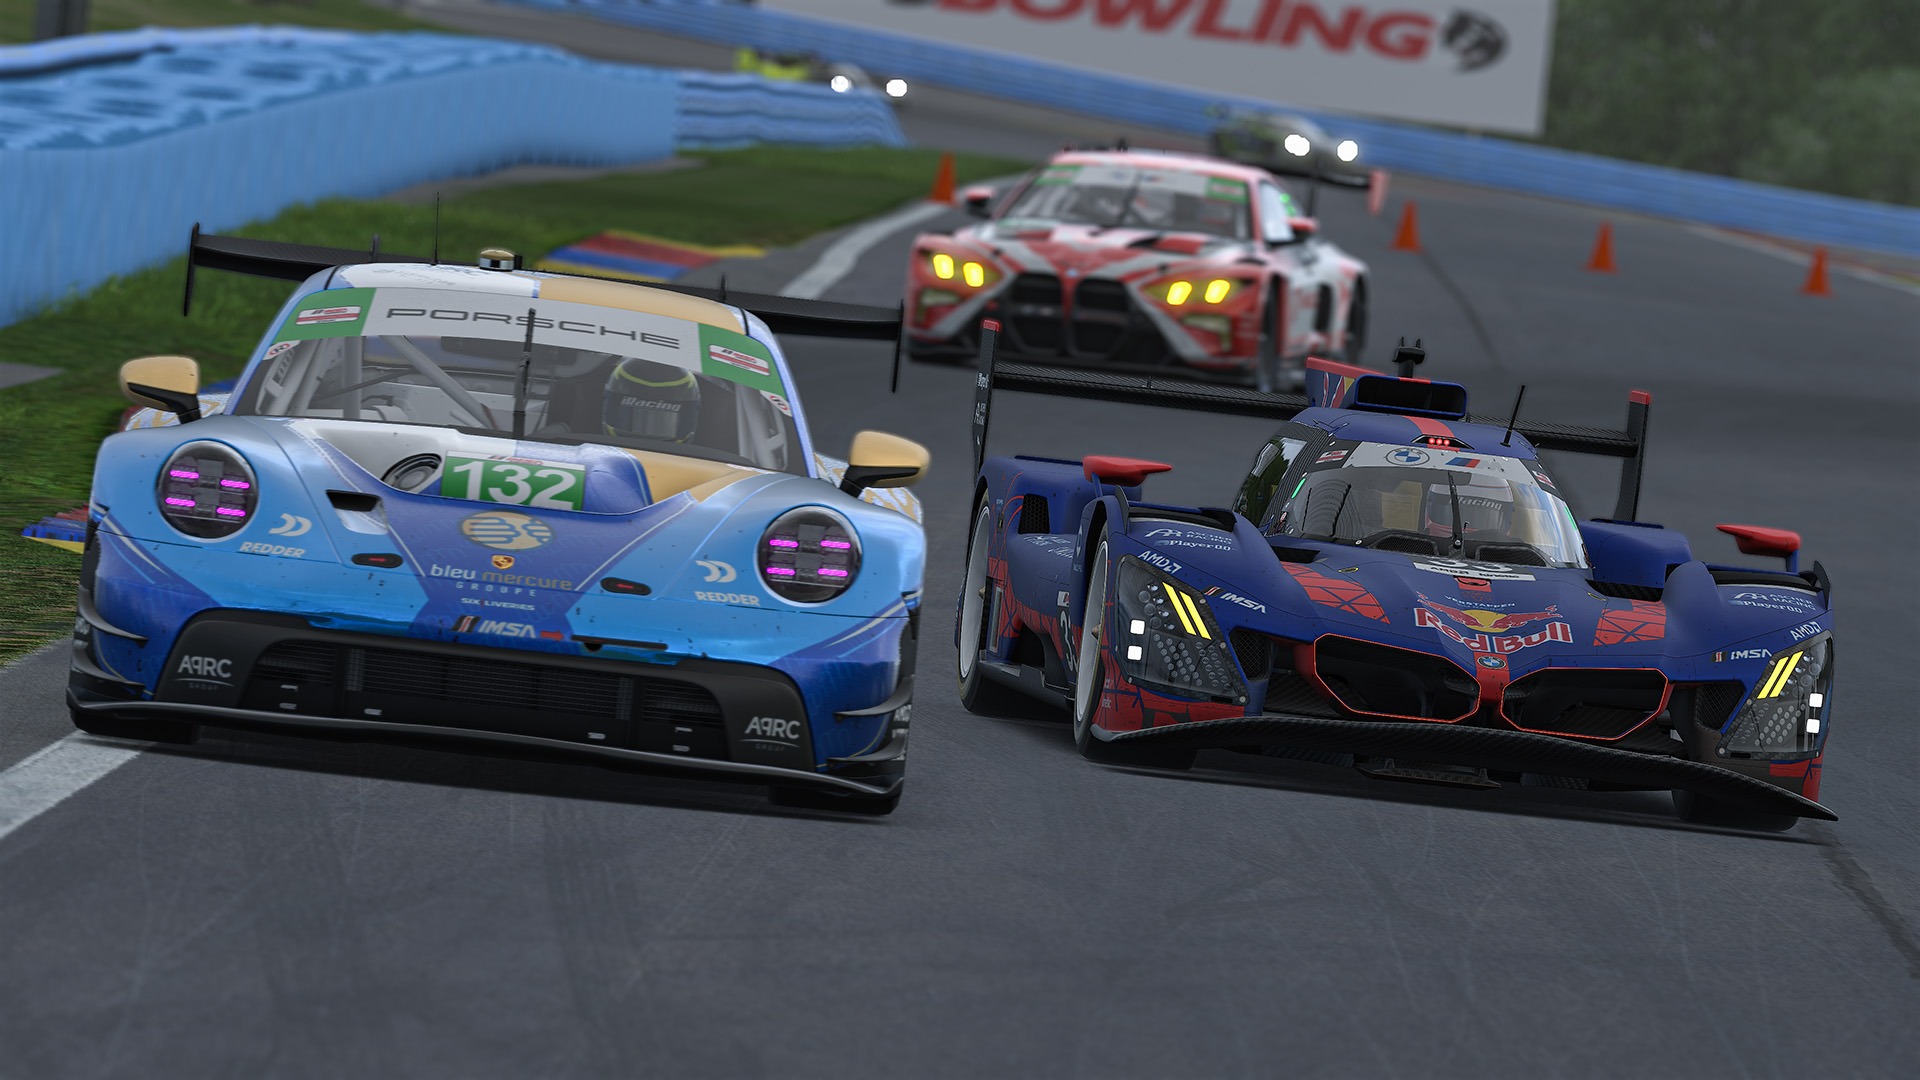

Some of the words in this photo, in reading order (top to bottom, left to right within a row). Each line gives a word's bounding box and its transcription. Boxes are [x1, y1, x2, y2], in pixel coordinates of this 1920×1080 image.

[930, 0, 1438, 63] WLING
[386, 308, 680, 350] PORSCHE
[621, 396, 681, 412] iRacing
[453, 461, 576, 510] 132
[239, 541, 306, 558] REDDER
[430, 564, 476, 579] bleu
[482, 571, 573, 591] mercure
[455, 582, 537, 597] GROUPE
[694, 591, 761, 606] REDDER
[484, 600, 536, 611] LIVERIES
[1220, 592, 1267, 614] IMSA
[477, 620, 536, 639] IMSA
[1413, 607, 1491, 653] Red
[1492, 622, 1574, 655] Bull
[1731, 649, 1772, 660] IMSA
